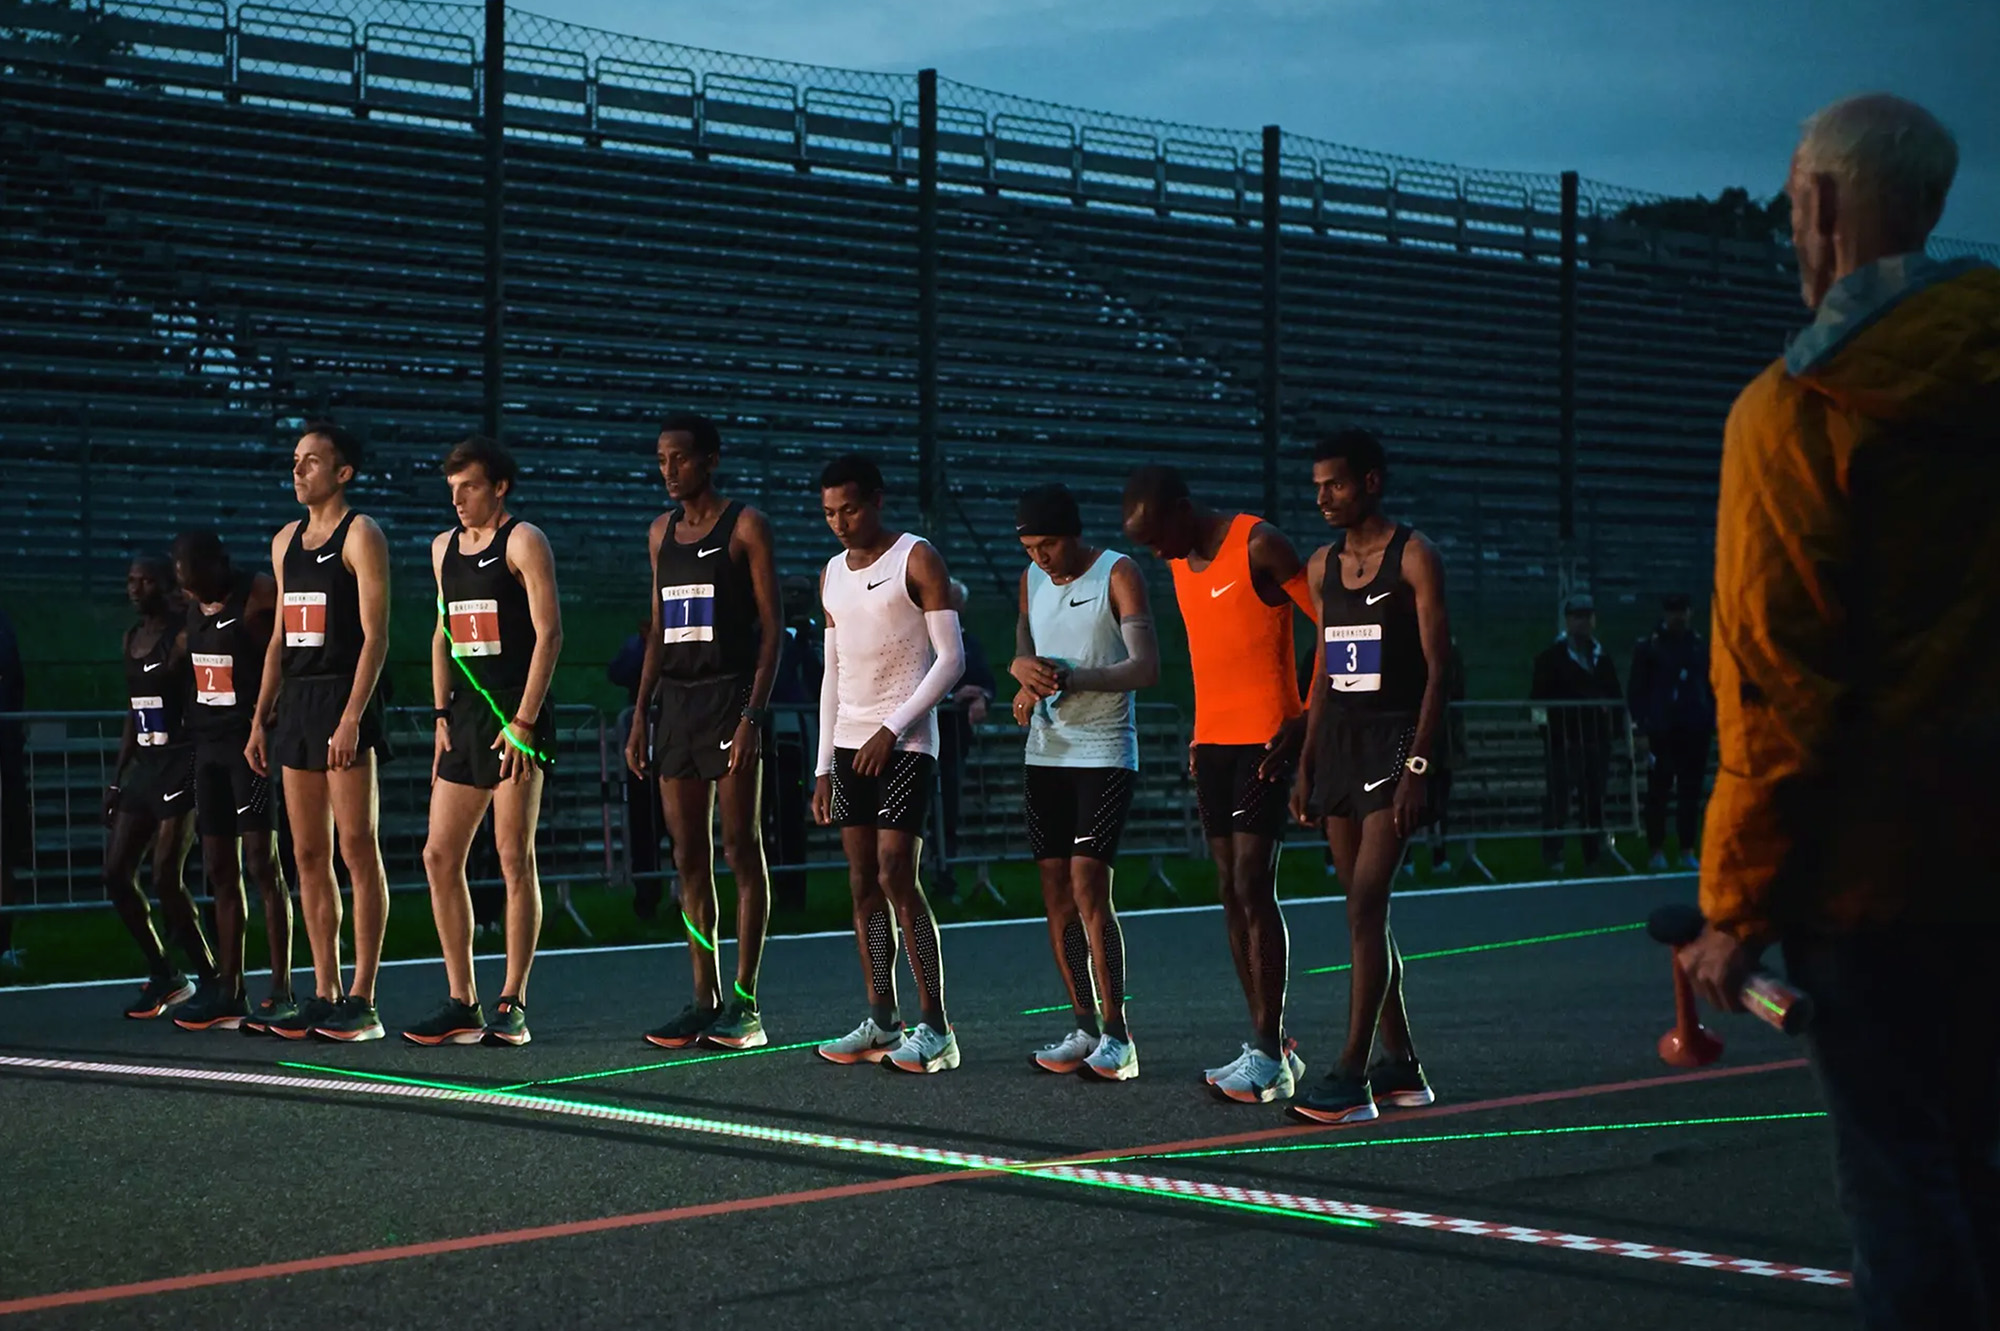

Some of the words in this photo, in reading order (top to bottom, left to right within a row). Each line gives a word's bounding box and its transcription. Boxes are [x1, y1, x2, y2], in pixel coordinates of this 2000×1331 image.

[300, 606, 307, 631] 1
[683, 600, 689, 625] 1
[470, 614, 478, 640] 3
[1346, 642, 1357, 672] 3
[205, 667, 216, 690] 2
